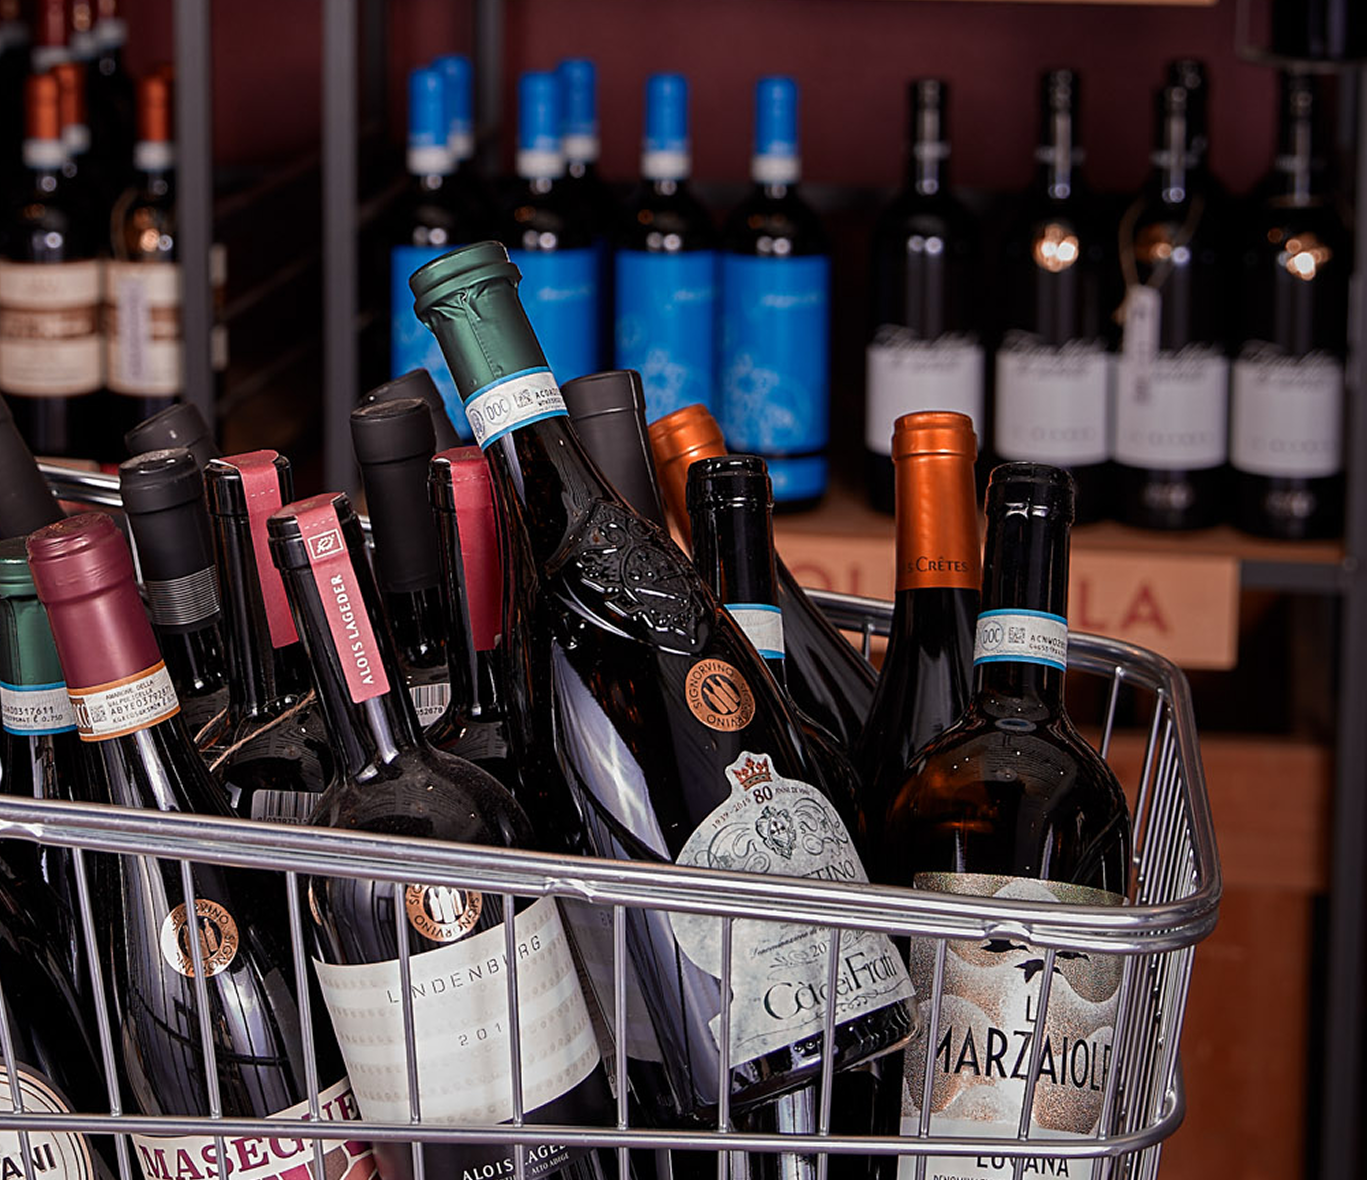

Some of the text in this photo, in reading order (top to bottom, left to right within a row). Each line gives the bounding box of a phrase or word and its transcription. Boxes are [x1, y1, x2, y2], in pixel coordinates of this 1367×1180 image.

[486, 399, 508, 421] DOC
[330, 574, 375, 686] ALOIS LAGEDER
[688, 662, 734, 709] SIGNORVINO
[752, 785, 773, 804] 80
[386, 934, 542, 1004] LNDENBRG
[457, 1022, 503, 1047] 201
